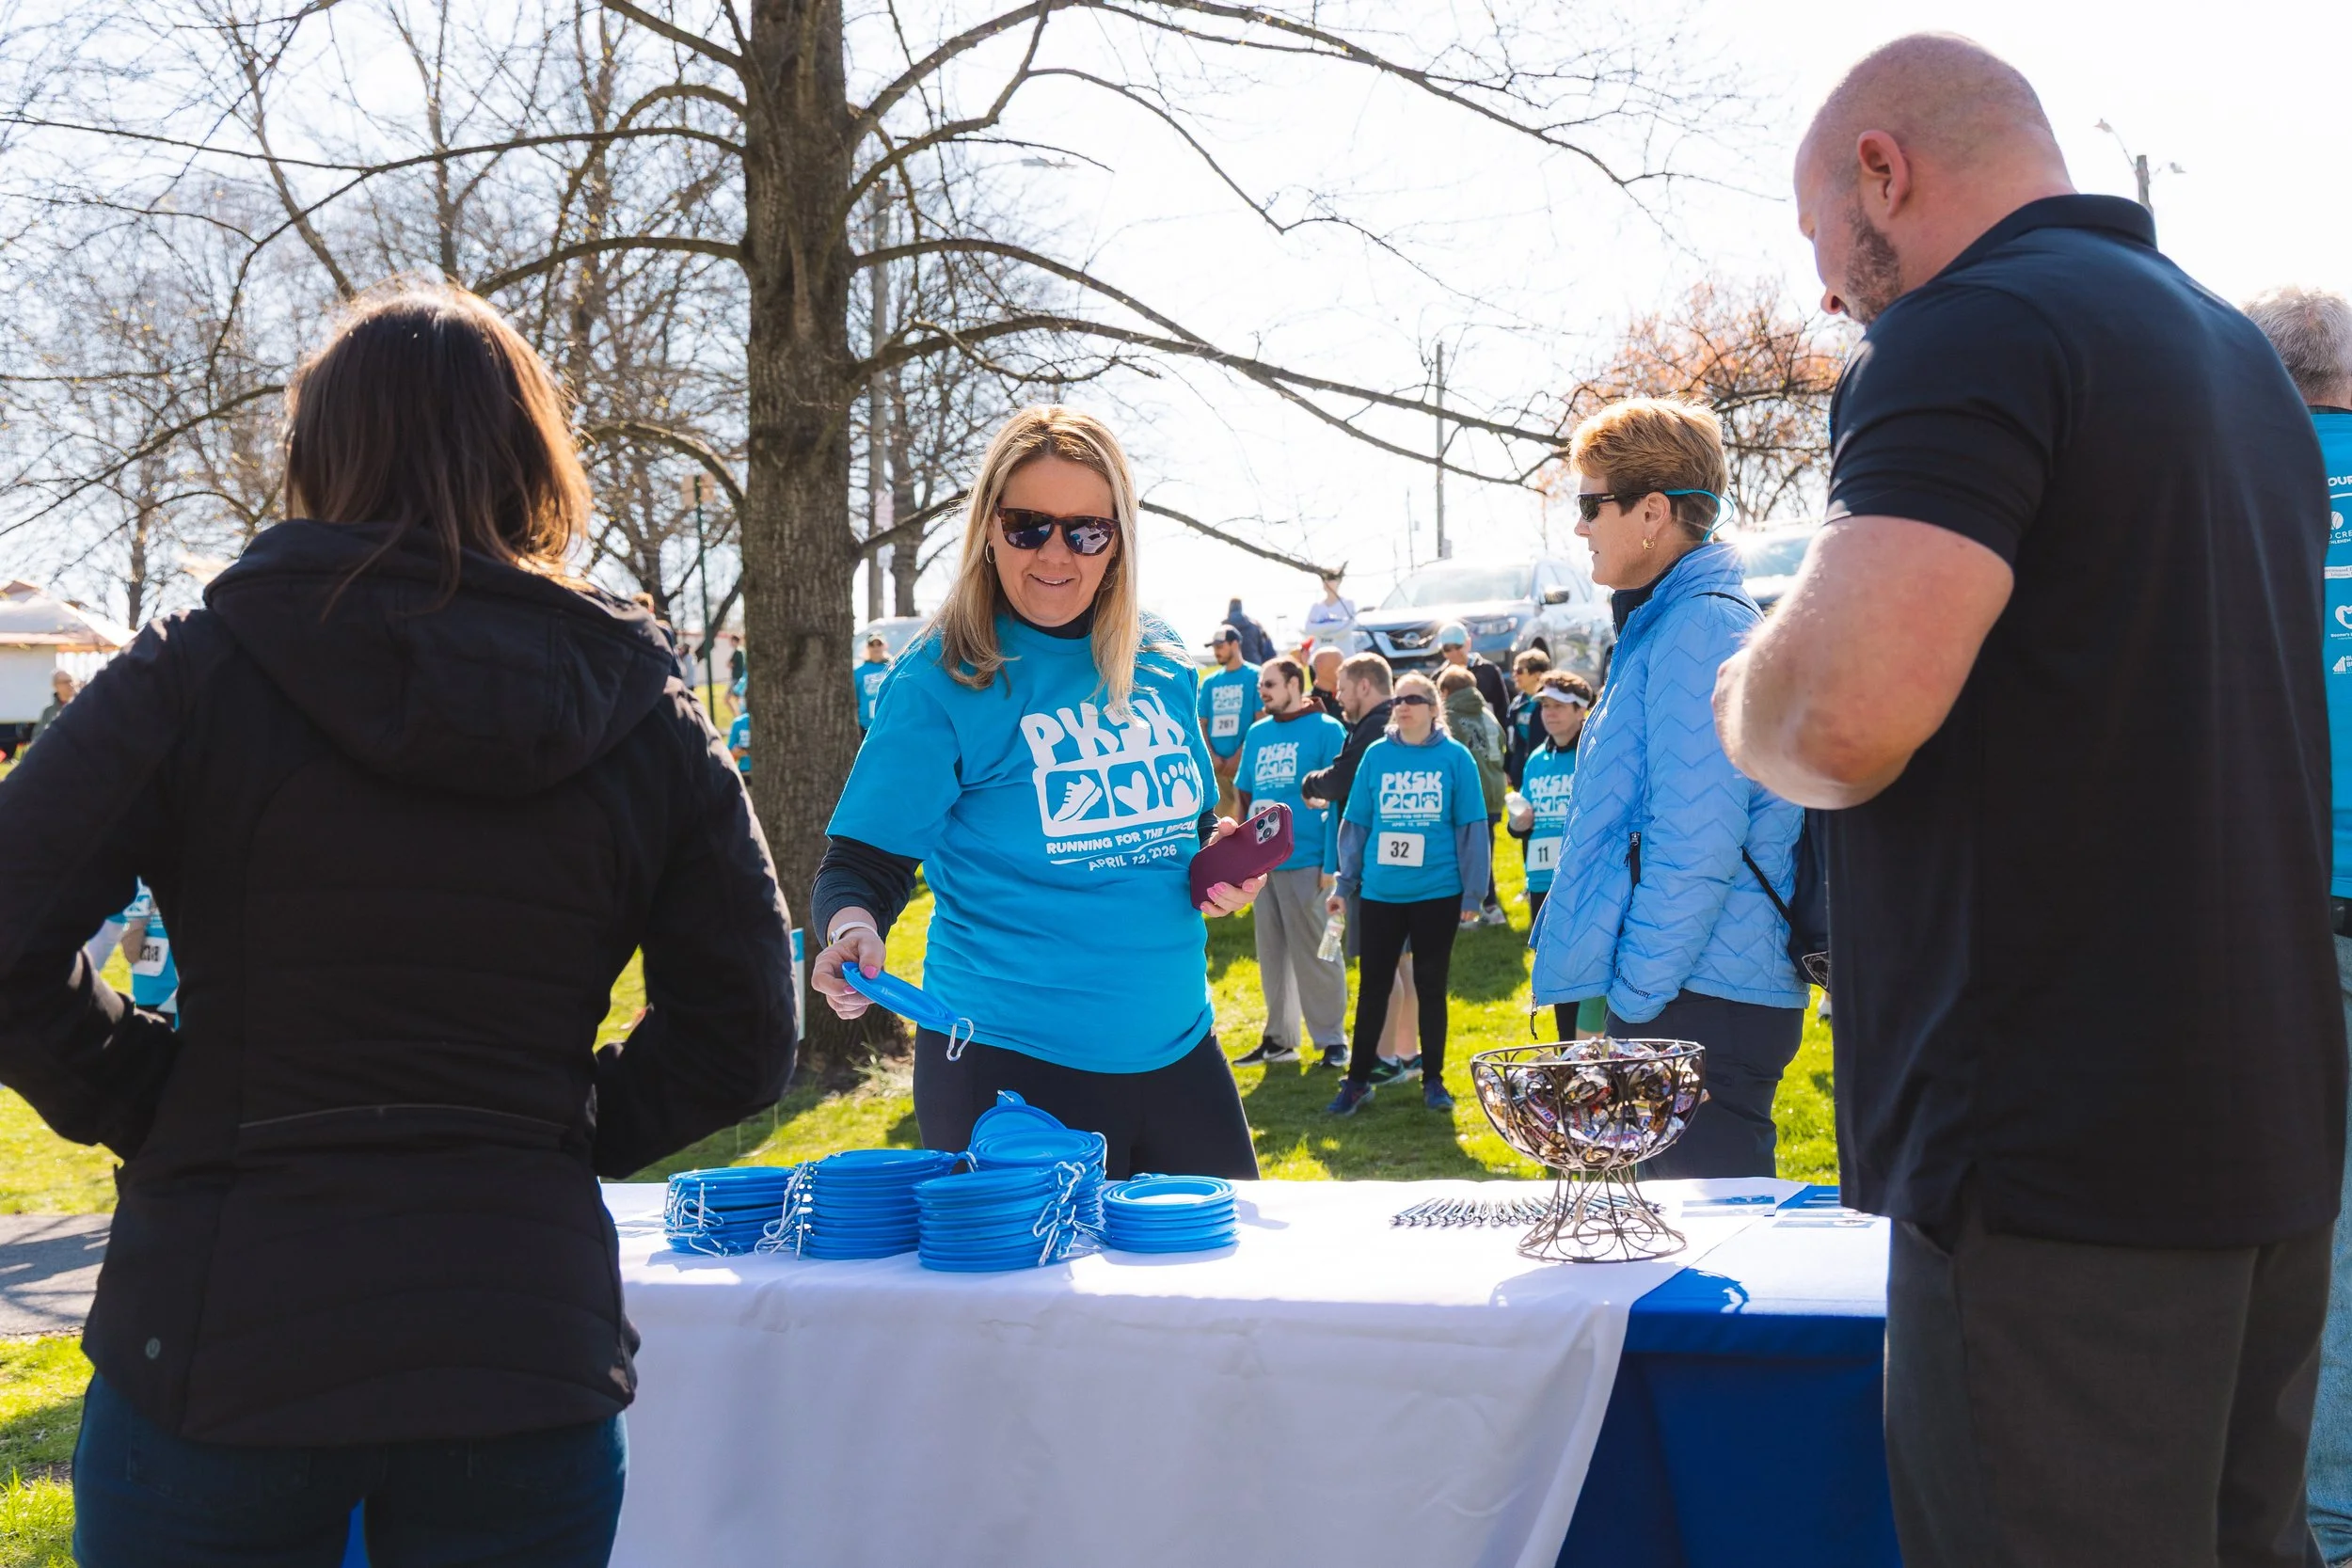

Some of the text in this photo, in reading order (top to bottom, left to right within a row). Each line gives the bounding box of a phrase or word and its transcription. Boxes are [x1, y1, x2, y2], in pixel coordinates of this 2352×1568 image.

[1046, 838, 1113, 855] RUNNING
[1115, 832, 1142, 847] FOR
[1142, 827, 1165, 840] THE
[1390, 840, 1409, 858] 32
[1089, 855, 1127, 871] APRIL
[1132, 854, 1151, 864] 12,
[1537, 847, 1549, 863] 11
